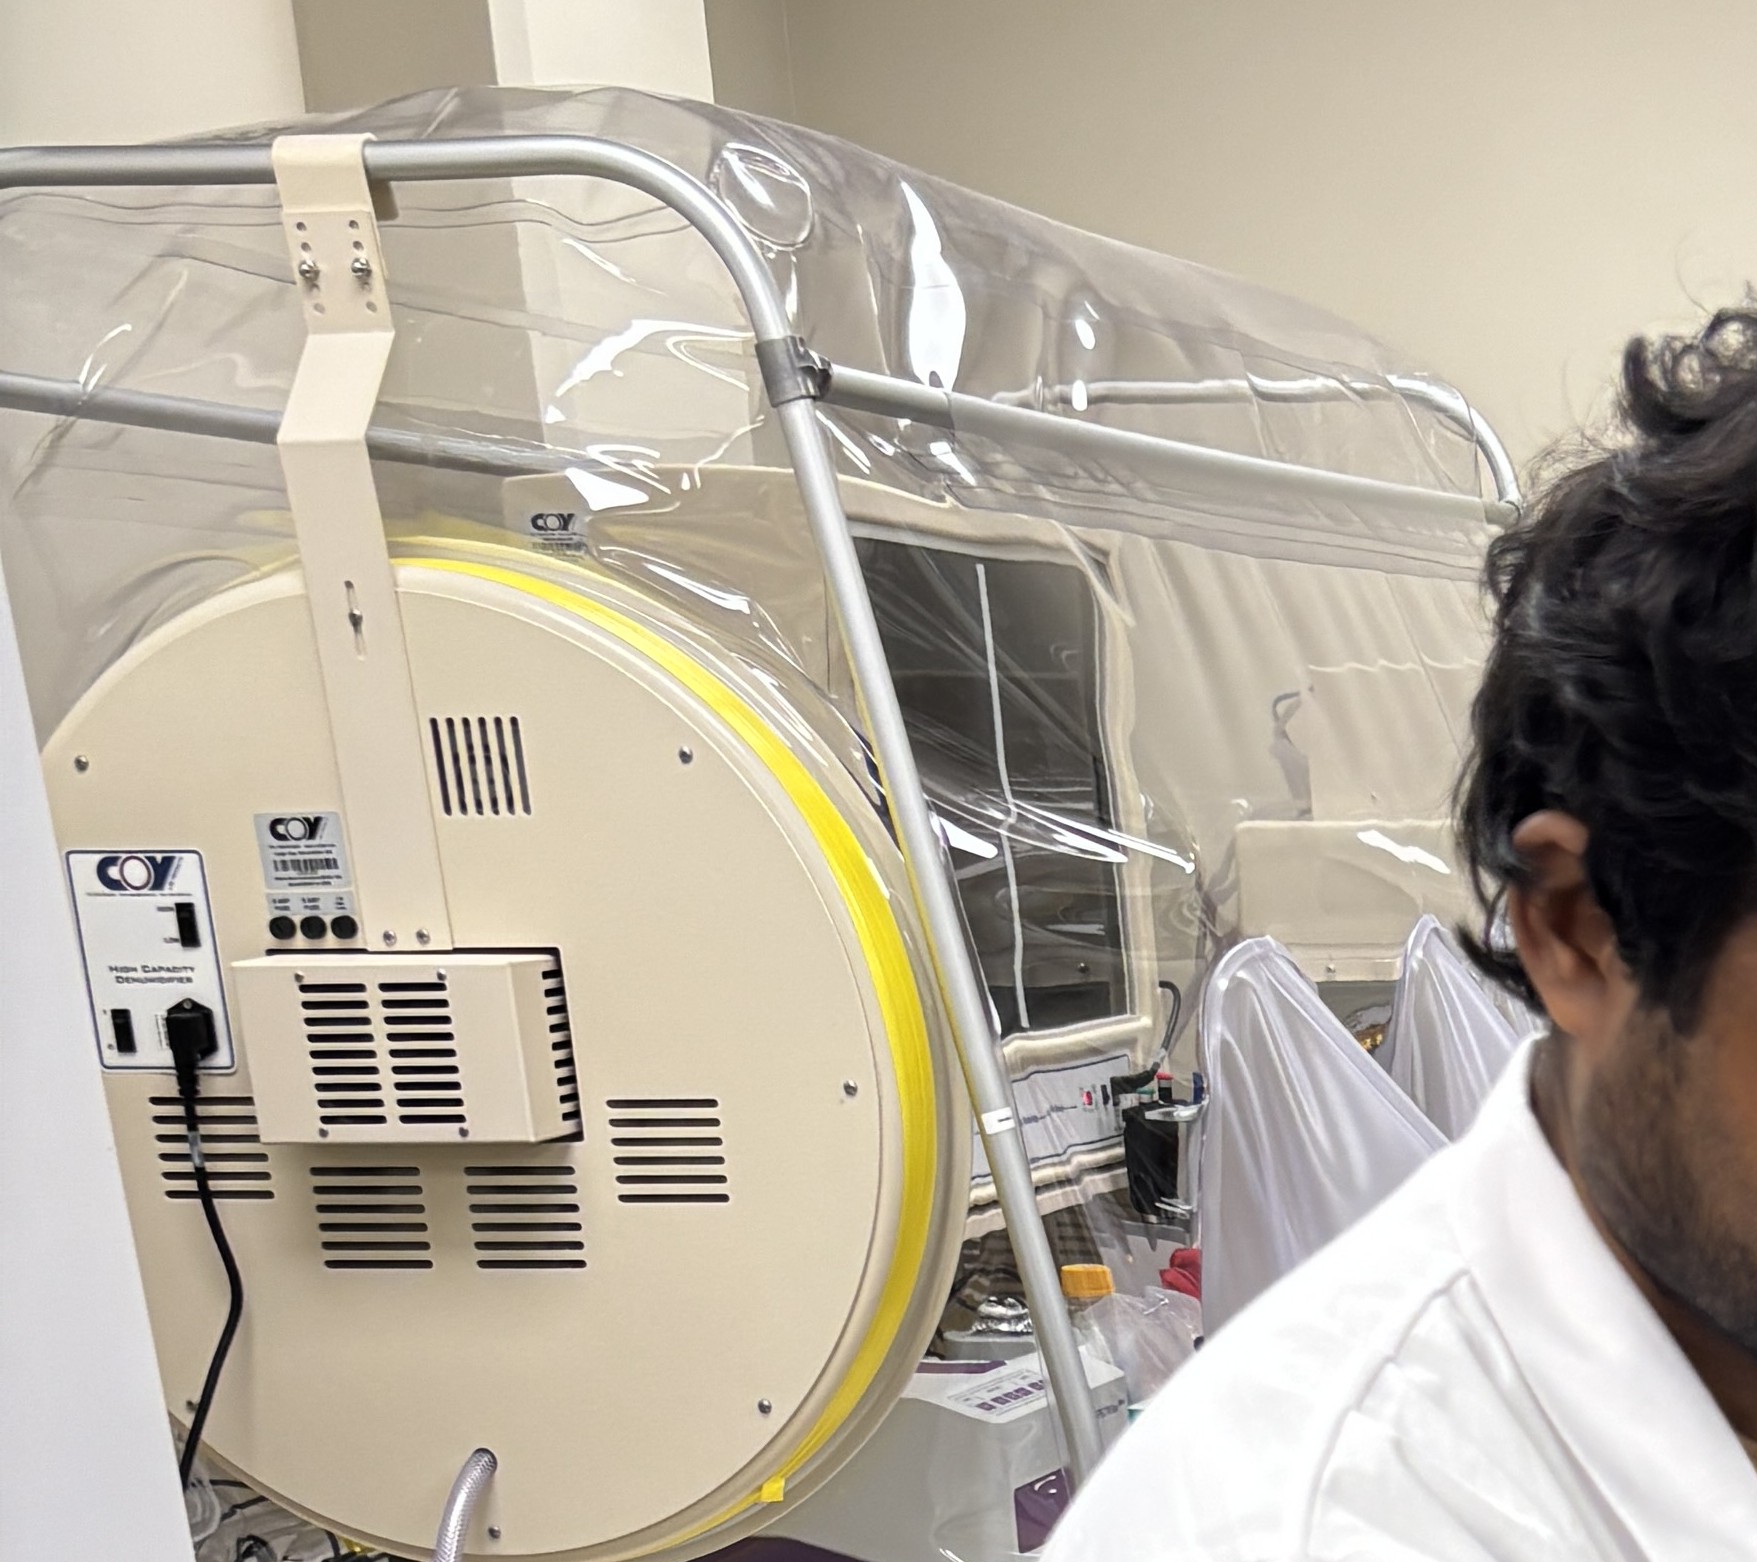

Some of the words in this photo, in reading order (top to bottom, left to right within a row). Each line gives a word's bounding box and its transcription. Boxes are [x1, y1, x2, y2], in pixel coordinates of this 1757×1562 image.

[531, 512, 575, 532] COY
[269, 815, 323, 842] COY
[96, 855, 176, 891] COY
